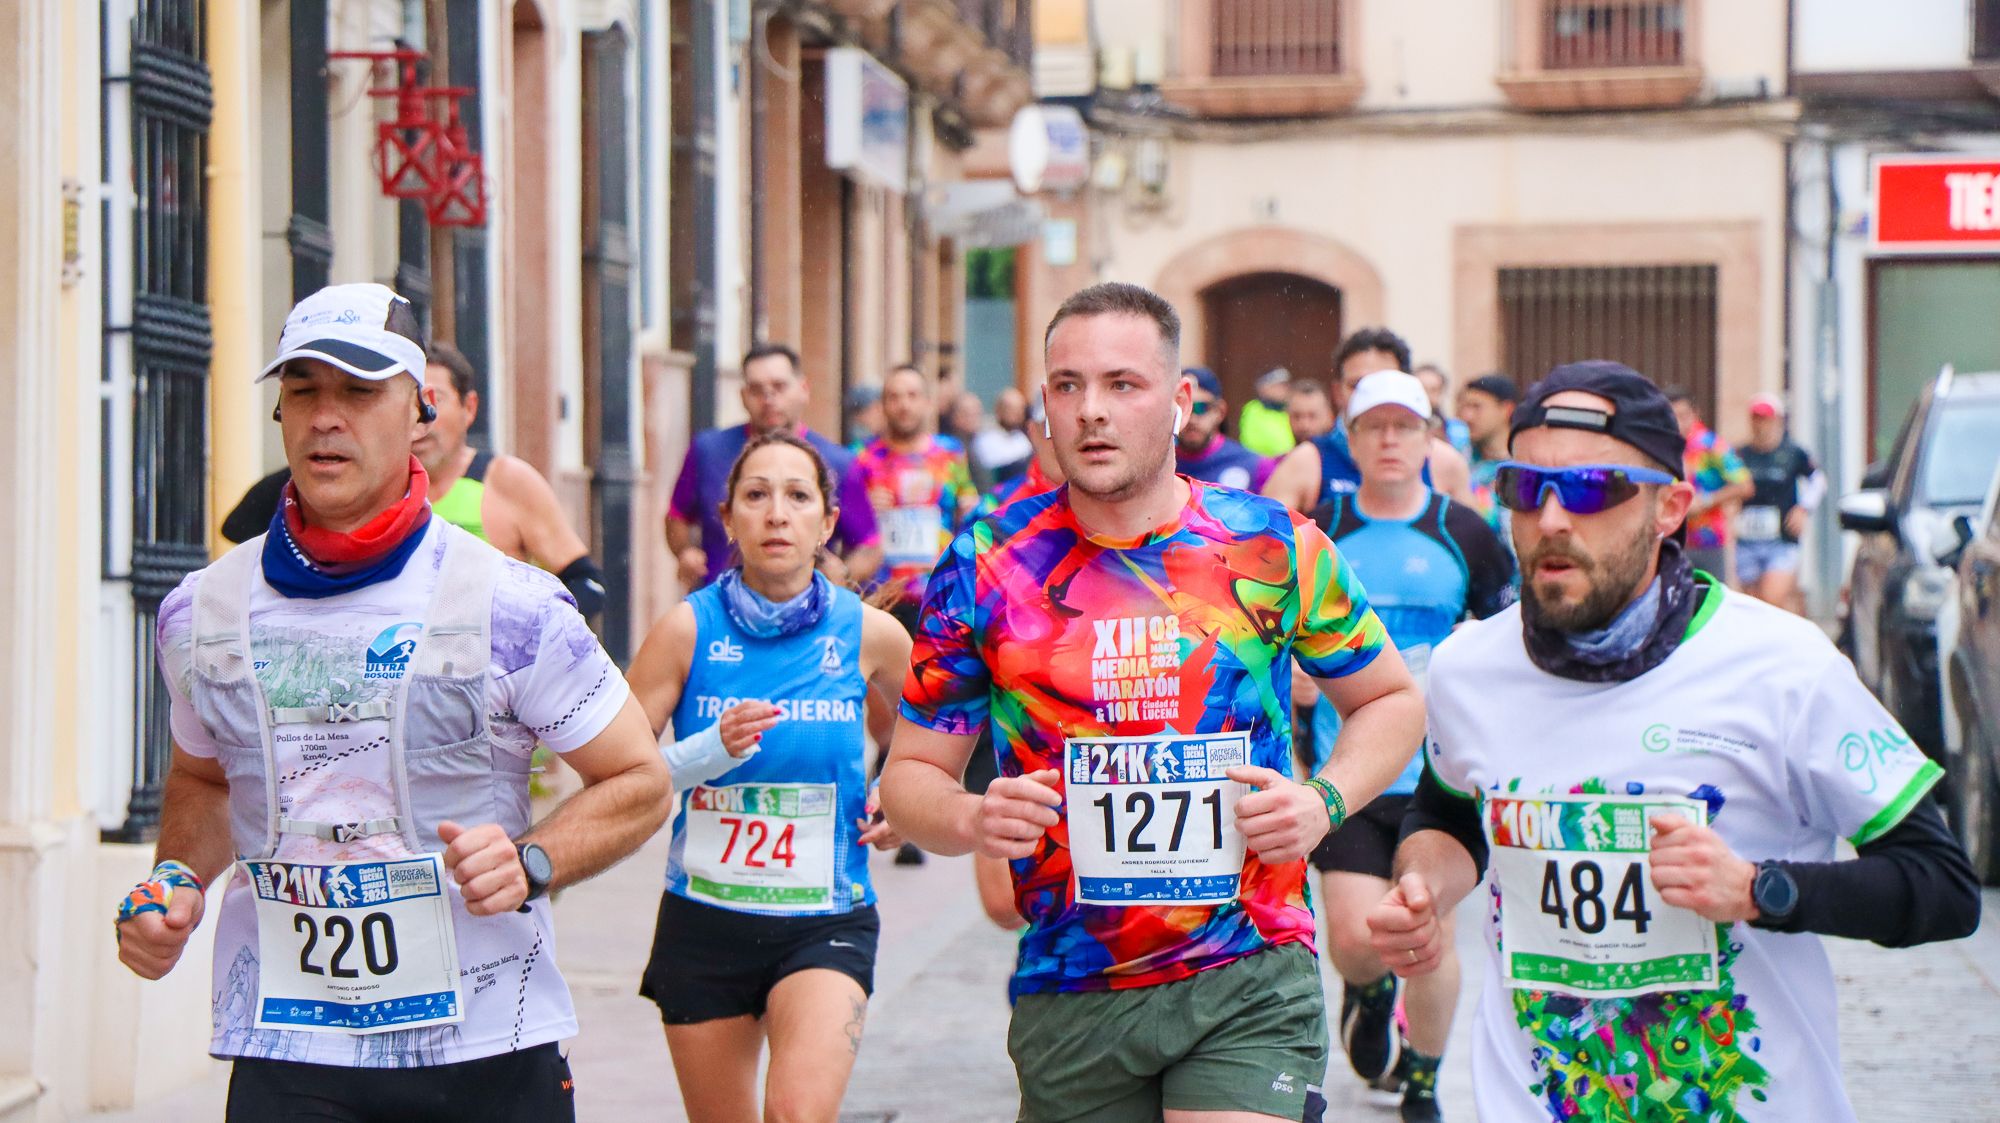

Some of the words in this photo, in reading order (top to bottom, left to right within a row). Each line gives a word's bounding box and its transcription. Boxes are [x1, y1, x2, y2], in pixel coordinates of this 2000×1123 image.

[1149, 615, 1180, 641] 08
[1092, 617, 1147, 659] XII
[708, 635, 744, 662] als
[1150, 643, 1180, 653] MARZO
[365, 663, 405, 672] ULTRA
[1092, 657, 1150, 680] MEDIA
[1150, 654, 1180, 668] 2026
[1092, 672, 1180, 701] MARATÓN
[697, 695, 856, 722] TROSIERRA
[1095, 707, 1105, 723] &
[1106, 700, 1140, 722] 10K
[1142, 699, 1169, 709] Ciudad
[1170, 699, 1179, 707] de
[1142, 707, 1180, 720] LUCENA
[276, 733, 300, 742] Pollos
[303, 733, 313, 741] de
[315, 733, 325, 741] La
[327, 732, 349, 740] Mesa
[300, 744, 327, 752] 1700m
[303, 753, 327, 761] Km40
[1210, 747, 1238, 755] carreras
[1091, 743, 1150, 783] 21K
[1210, 752, 1242, 763] populares
[1184, 766, 1207, 779] 2026
[700, 787, 745, 812] 10K
[1093, 789, 1223, 854] 1271
[1501, 802, 1566, 849] 10K
[720, 818, 796, 868] 724
[360, 872, 385, 883] LUCENA
[390, 867, 426, 876] carreras
[391, 872, 433, 883] populares
[270, 863, 328, 907] 21K
[362, 888, 388, 903] 2026
[1541, 860, 1652, 935] 484
[294, 912, 399, 978] 220
[470, 966, 480, 974] de
[481, 960, 500, 971] Santa
[500, 953, 519, 964] María
[1272, 1081, 1294, 1093] ipso
